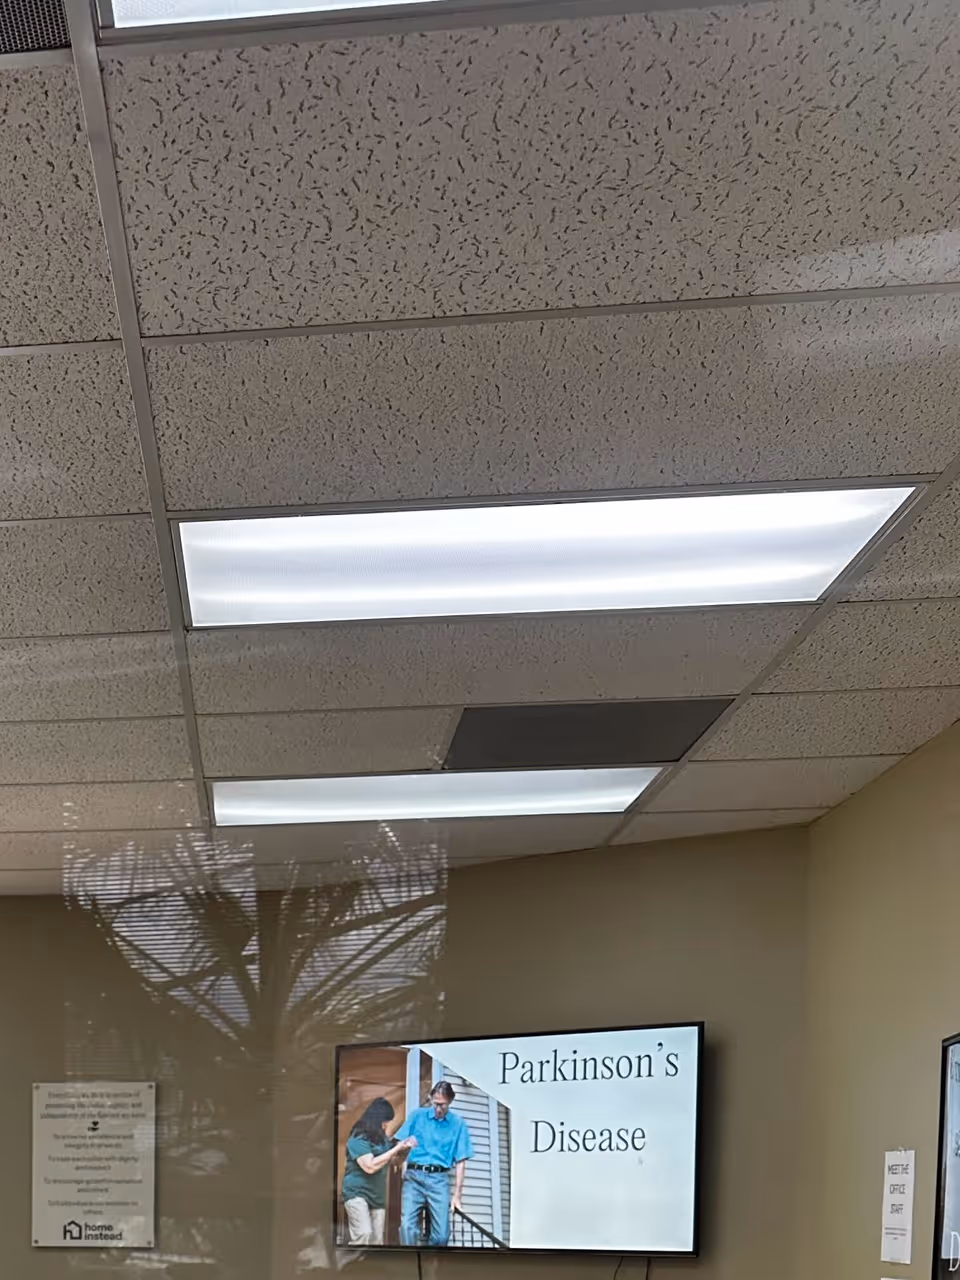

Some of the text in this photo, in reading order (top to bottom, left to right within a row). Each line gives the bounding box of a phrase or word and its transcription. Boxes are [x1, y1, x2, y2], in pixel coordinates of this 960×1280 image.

[498, 1042, 679, 1085] Parkinson's
[531, 1119, 646, 1154] Disease
[84, 1222, 114, 1231] home
[84, 1231, 123, 1241] instead
